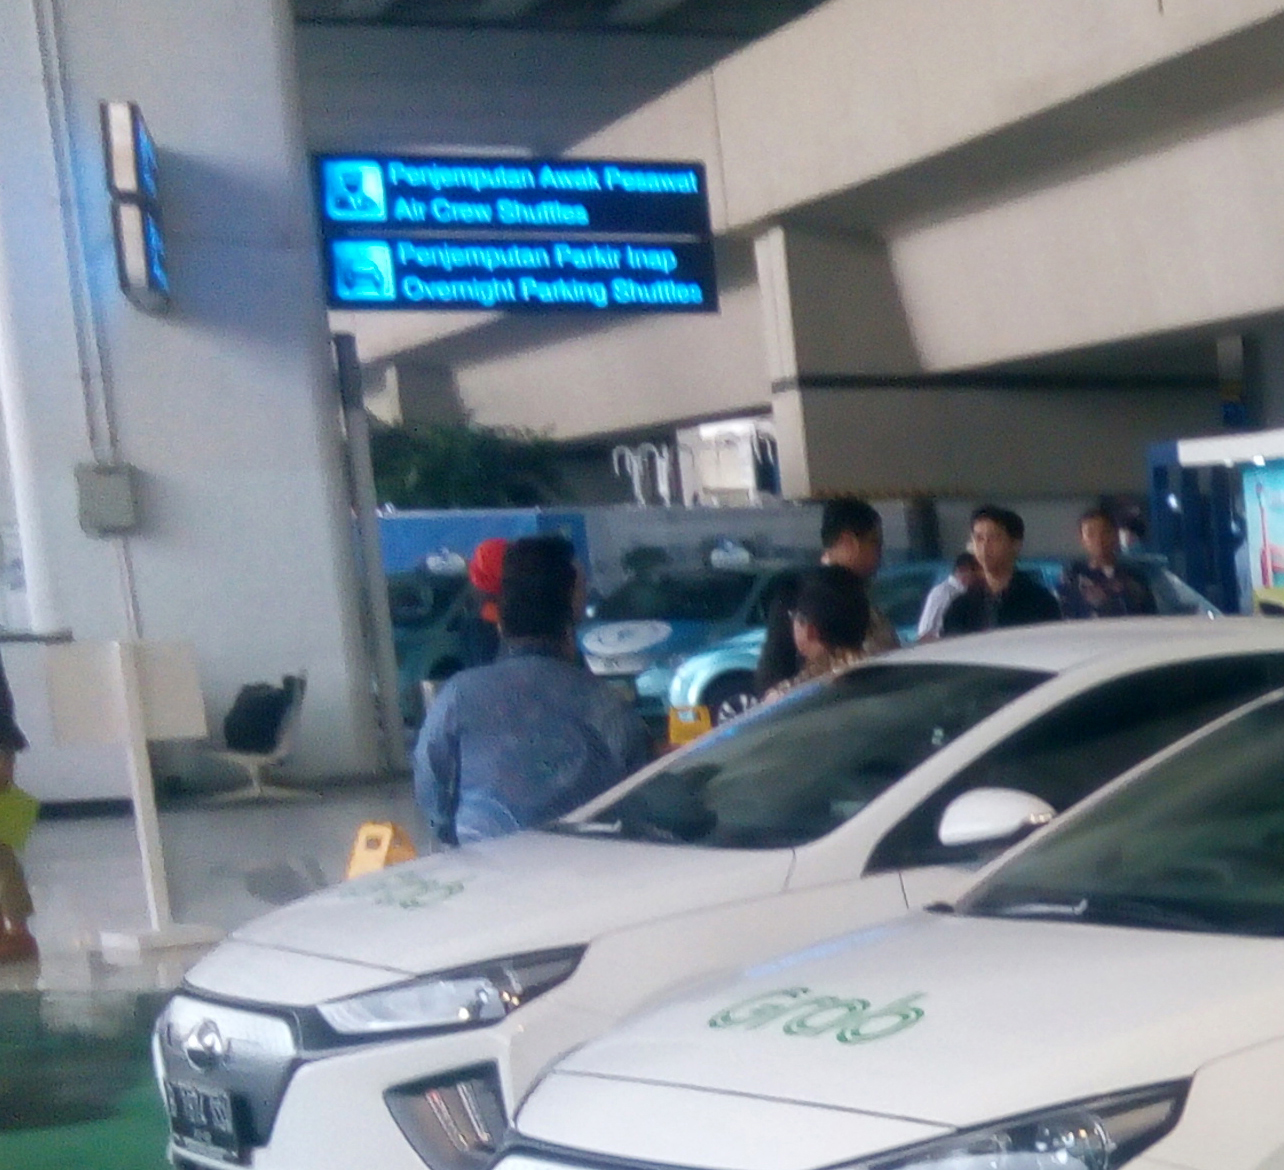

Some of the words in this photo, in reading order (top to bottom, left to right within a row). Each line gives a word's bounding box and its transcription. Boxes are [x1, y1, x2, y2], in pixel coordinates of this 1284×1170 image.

[394, 197, 426, 221] Air
[431, 197, 493, 222] Crew
[554, 242, 621, 269] Parkir
[625, 245, 678, 273] Inap
[402, 275, 516, 306] Overnight
[519, 275, 608, 307] Parking
[709, 986, 928, 1044] Grab
